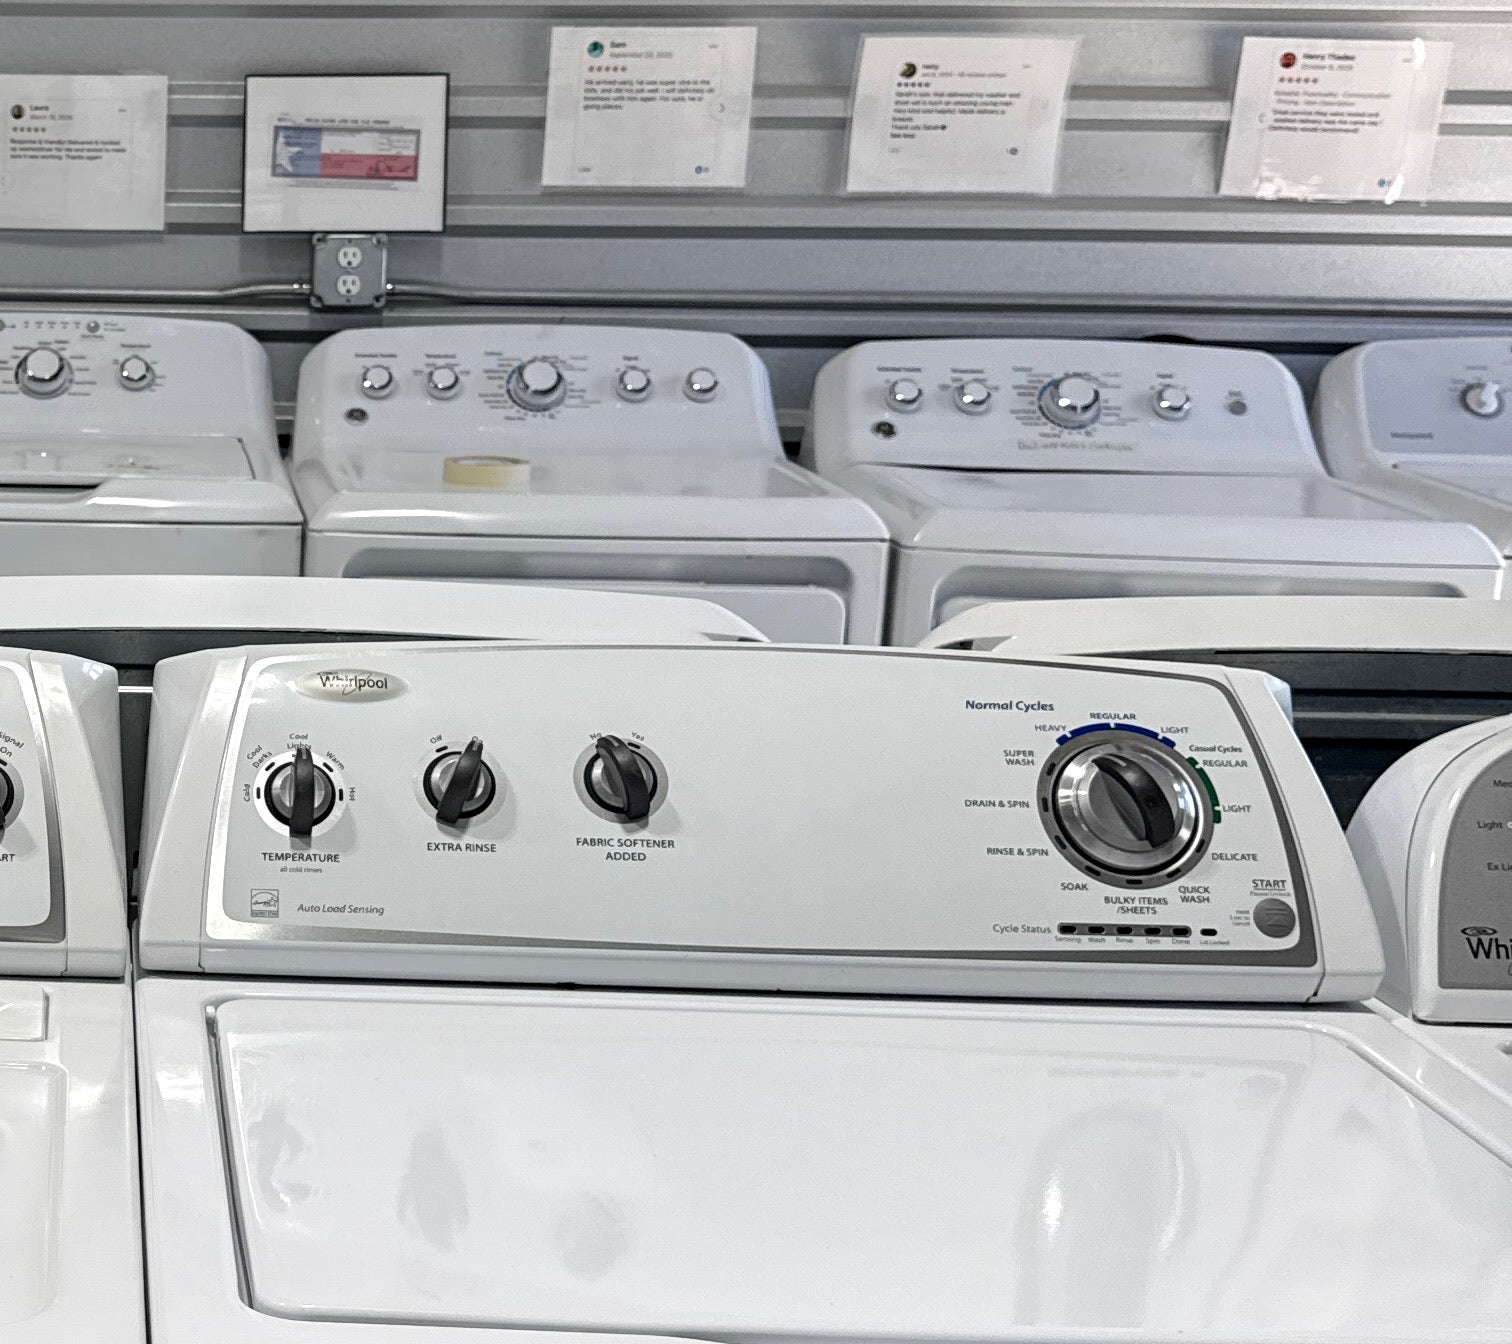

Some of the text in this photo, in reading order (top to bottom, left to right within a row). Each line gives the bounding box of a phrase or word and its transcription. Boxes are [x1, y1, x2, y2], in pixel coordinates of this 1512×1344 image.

[965, 700, 1055, 713] Normal Cycles
[1090, 712, 1136, 720] REGULAR
[1034, 724, 1066, 732] HEAVY
[1160, 726, 1189, 734] LIGHT
[429, 734, 443, 745] Off
[631, 731, 645, 742] Yes
[0, 746, 13, 757] On
[246, 745, 263, 760] Cool
[1003, 749, 1034, 757] SUPER
[1189, 744, 1242, 753] Casual Cycles
[252, 751, 273, 768] Darks
[326, 751, 345, 770] Warm
[1005, 758, 1035, 766] WASH
[1202, 759, 1248, 768] REGULAR
[243, 783, 251, 802] Cold
[348, 786, 356, 801] Hot
[964, 799, 996, 808] DRAIN
[1007, 800, 1030, 808] SPIN
[1222, 805, 1251, 813] LIGHT
[1477, 820, 1503, 830] Light
[427, 842, 497, 853] EXTRA RINSE
[576, 837, 675, 849] FABRIC SOFTENER
[605, 851, 647, 862] ADDED
[986, 847, 1014, 855] RINSE
[1026, 848, 1049, 856] SPIN
[261, 852, 340, 863] TEMPERATURE
[1211, 852, 1258, 862] DELICATE
[1487, 863, 1499, 871] Ex
[1060, 882, 1088, 891] SOAK
[1252, 879, 1286, 889] START
[1178, 885, 1210, 894] QUICK
[1104, 896, 1168, 905] BULKY ITEMS
[1180, 895, 1210, 904] WASH
[297, 903, 385, 916] Auto Load Sensing
[1116, 906, 1157, 915] /SHEETS
[992, 924, 1051, 934] Cycle Status
